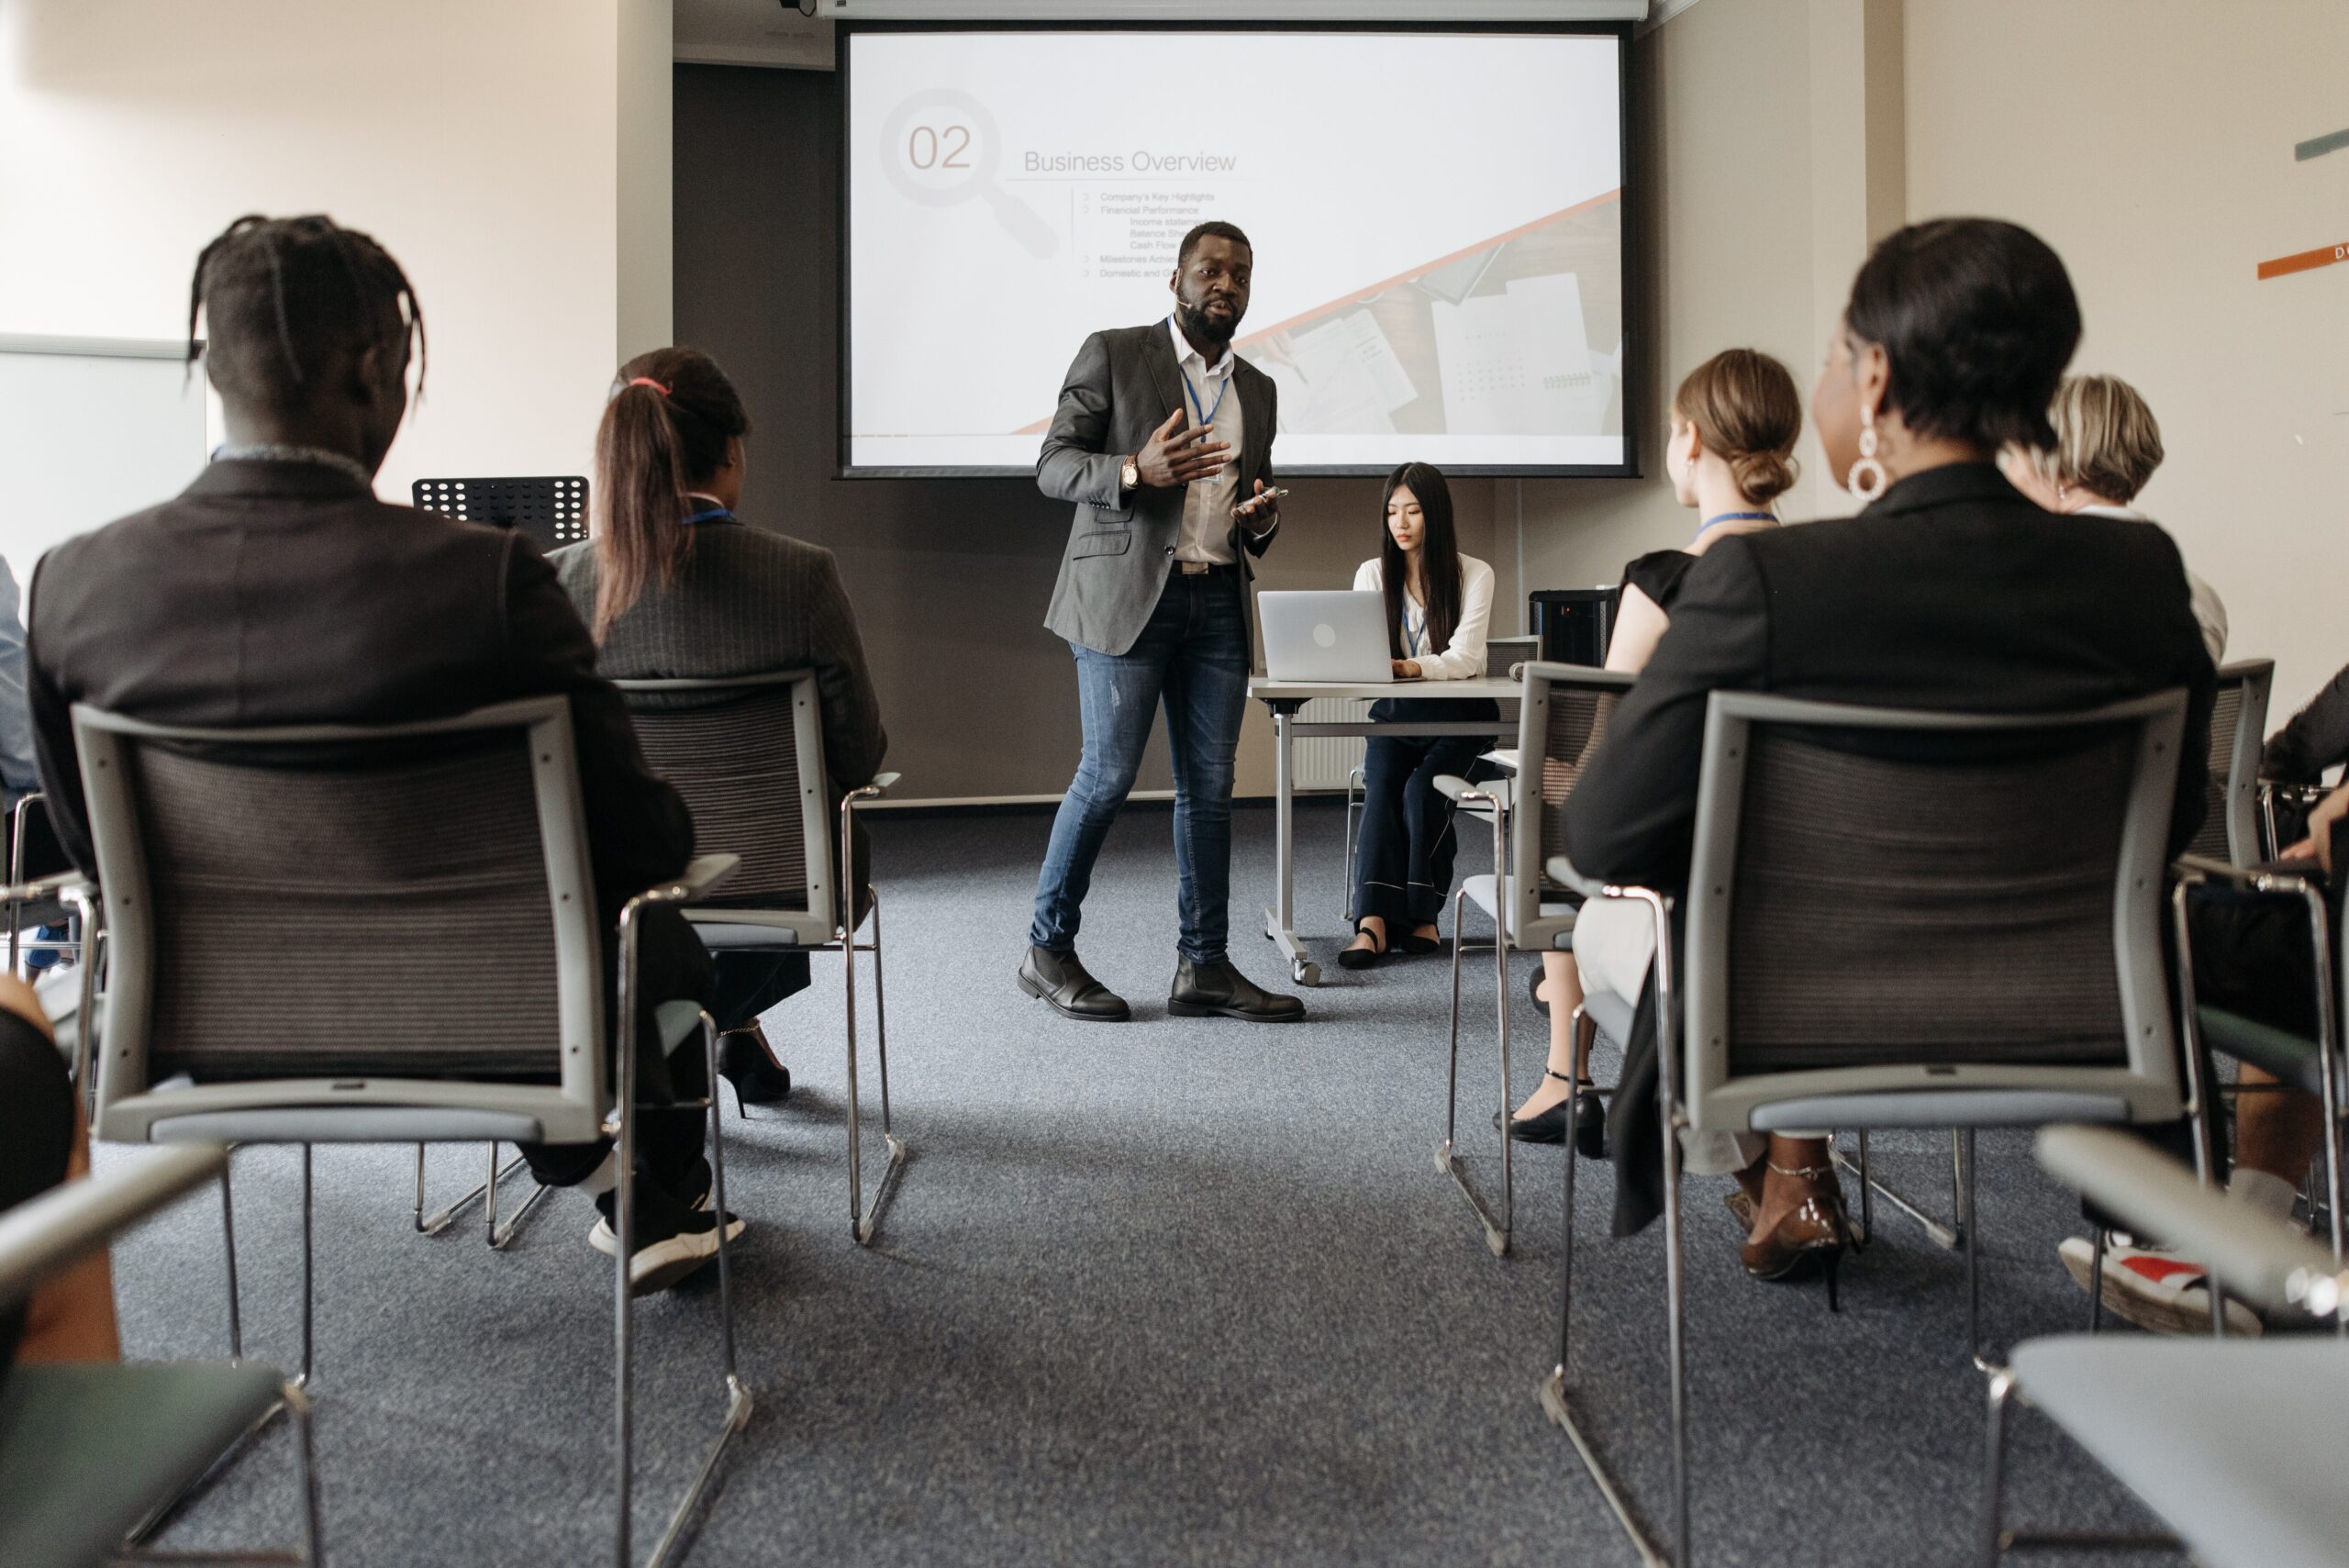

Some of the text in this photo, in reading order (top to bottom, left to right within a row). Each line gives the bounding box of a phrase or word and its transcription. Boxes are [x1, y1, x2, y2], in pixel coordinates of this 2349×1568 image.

[908, 126, 972, 170] 02
[1025, 151, 1237, 172] Business Overview
[1100, 193, 1215, 203] Company's Key Highlights
[1100, 206, 1199, 215] Financial Performance
[1130, 218, 1163, 227] Income
[1130, 229, 1186, 239] Balance She
[1130, 241, 1176, 250] Cash Flow
[2335, 245, 2349, 259] D
[1099, 256, 1178, 264] Milestones Achiev
[1099, 269, 1141, 278] Domestic
[1143, 269, 1160, 278] and
